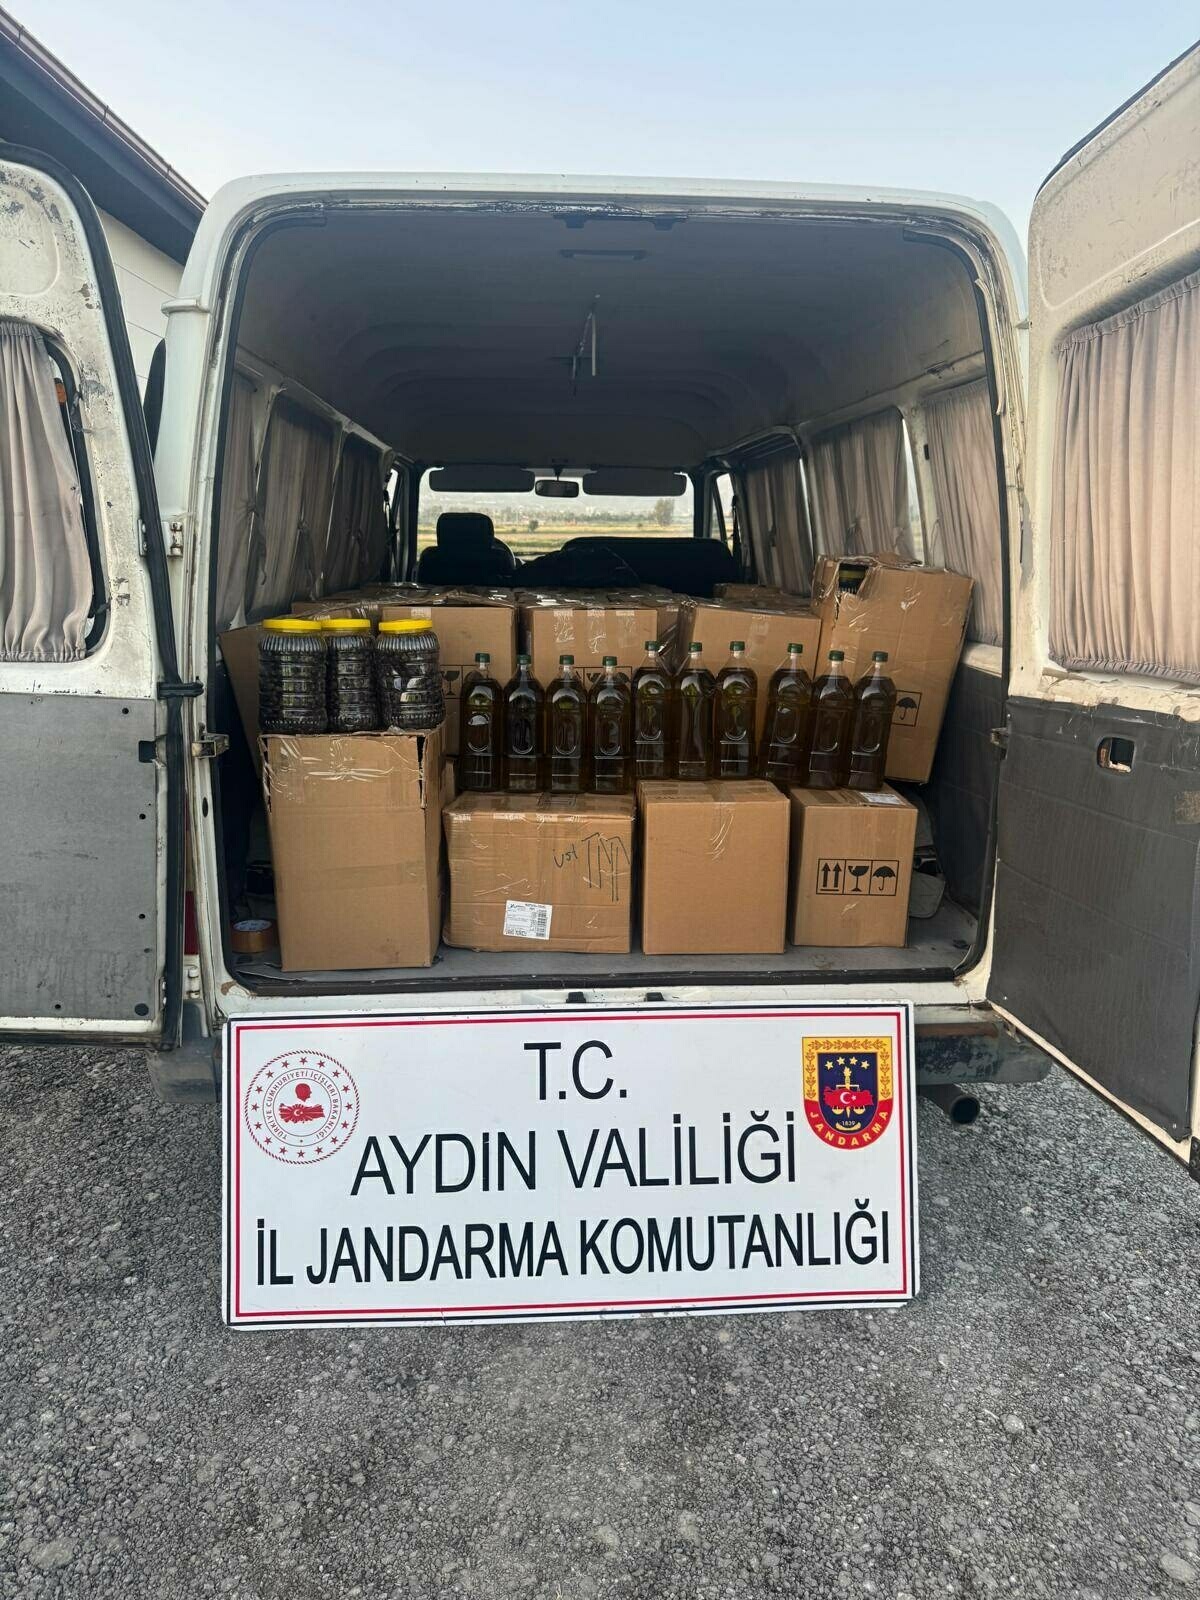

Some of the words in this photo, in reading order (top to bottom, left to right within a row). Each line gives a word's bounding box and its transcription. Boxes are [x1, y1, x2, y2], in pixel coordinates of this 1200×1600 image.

[265, 1070, 309, 1108] CUMHURİYETİ
[310, 1070, 338, 1097] İÇİŞLERİ
[523, 1039, 627, 1101] T.C.
[351, 1130, 536, 1196] AYDIN
[557, 1110, 796, 1189] VALİLİĞİ
[809, 1110, 889, 1147] JANDARMA
[257, 1218, 294, 1286] İL
[306, 1220, 569, 1285] JANDARMA
[580, 1198, 890, 1275] KOMUTANLIĞI
